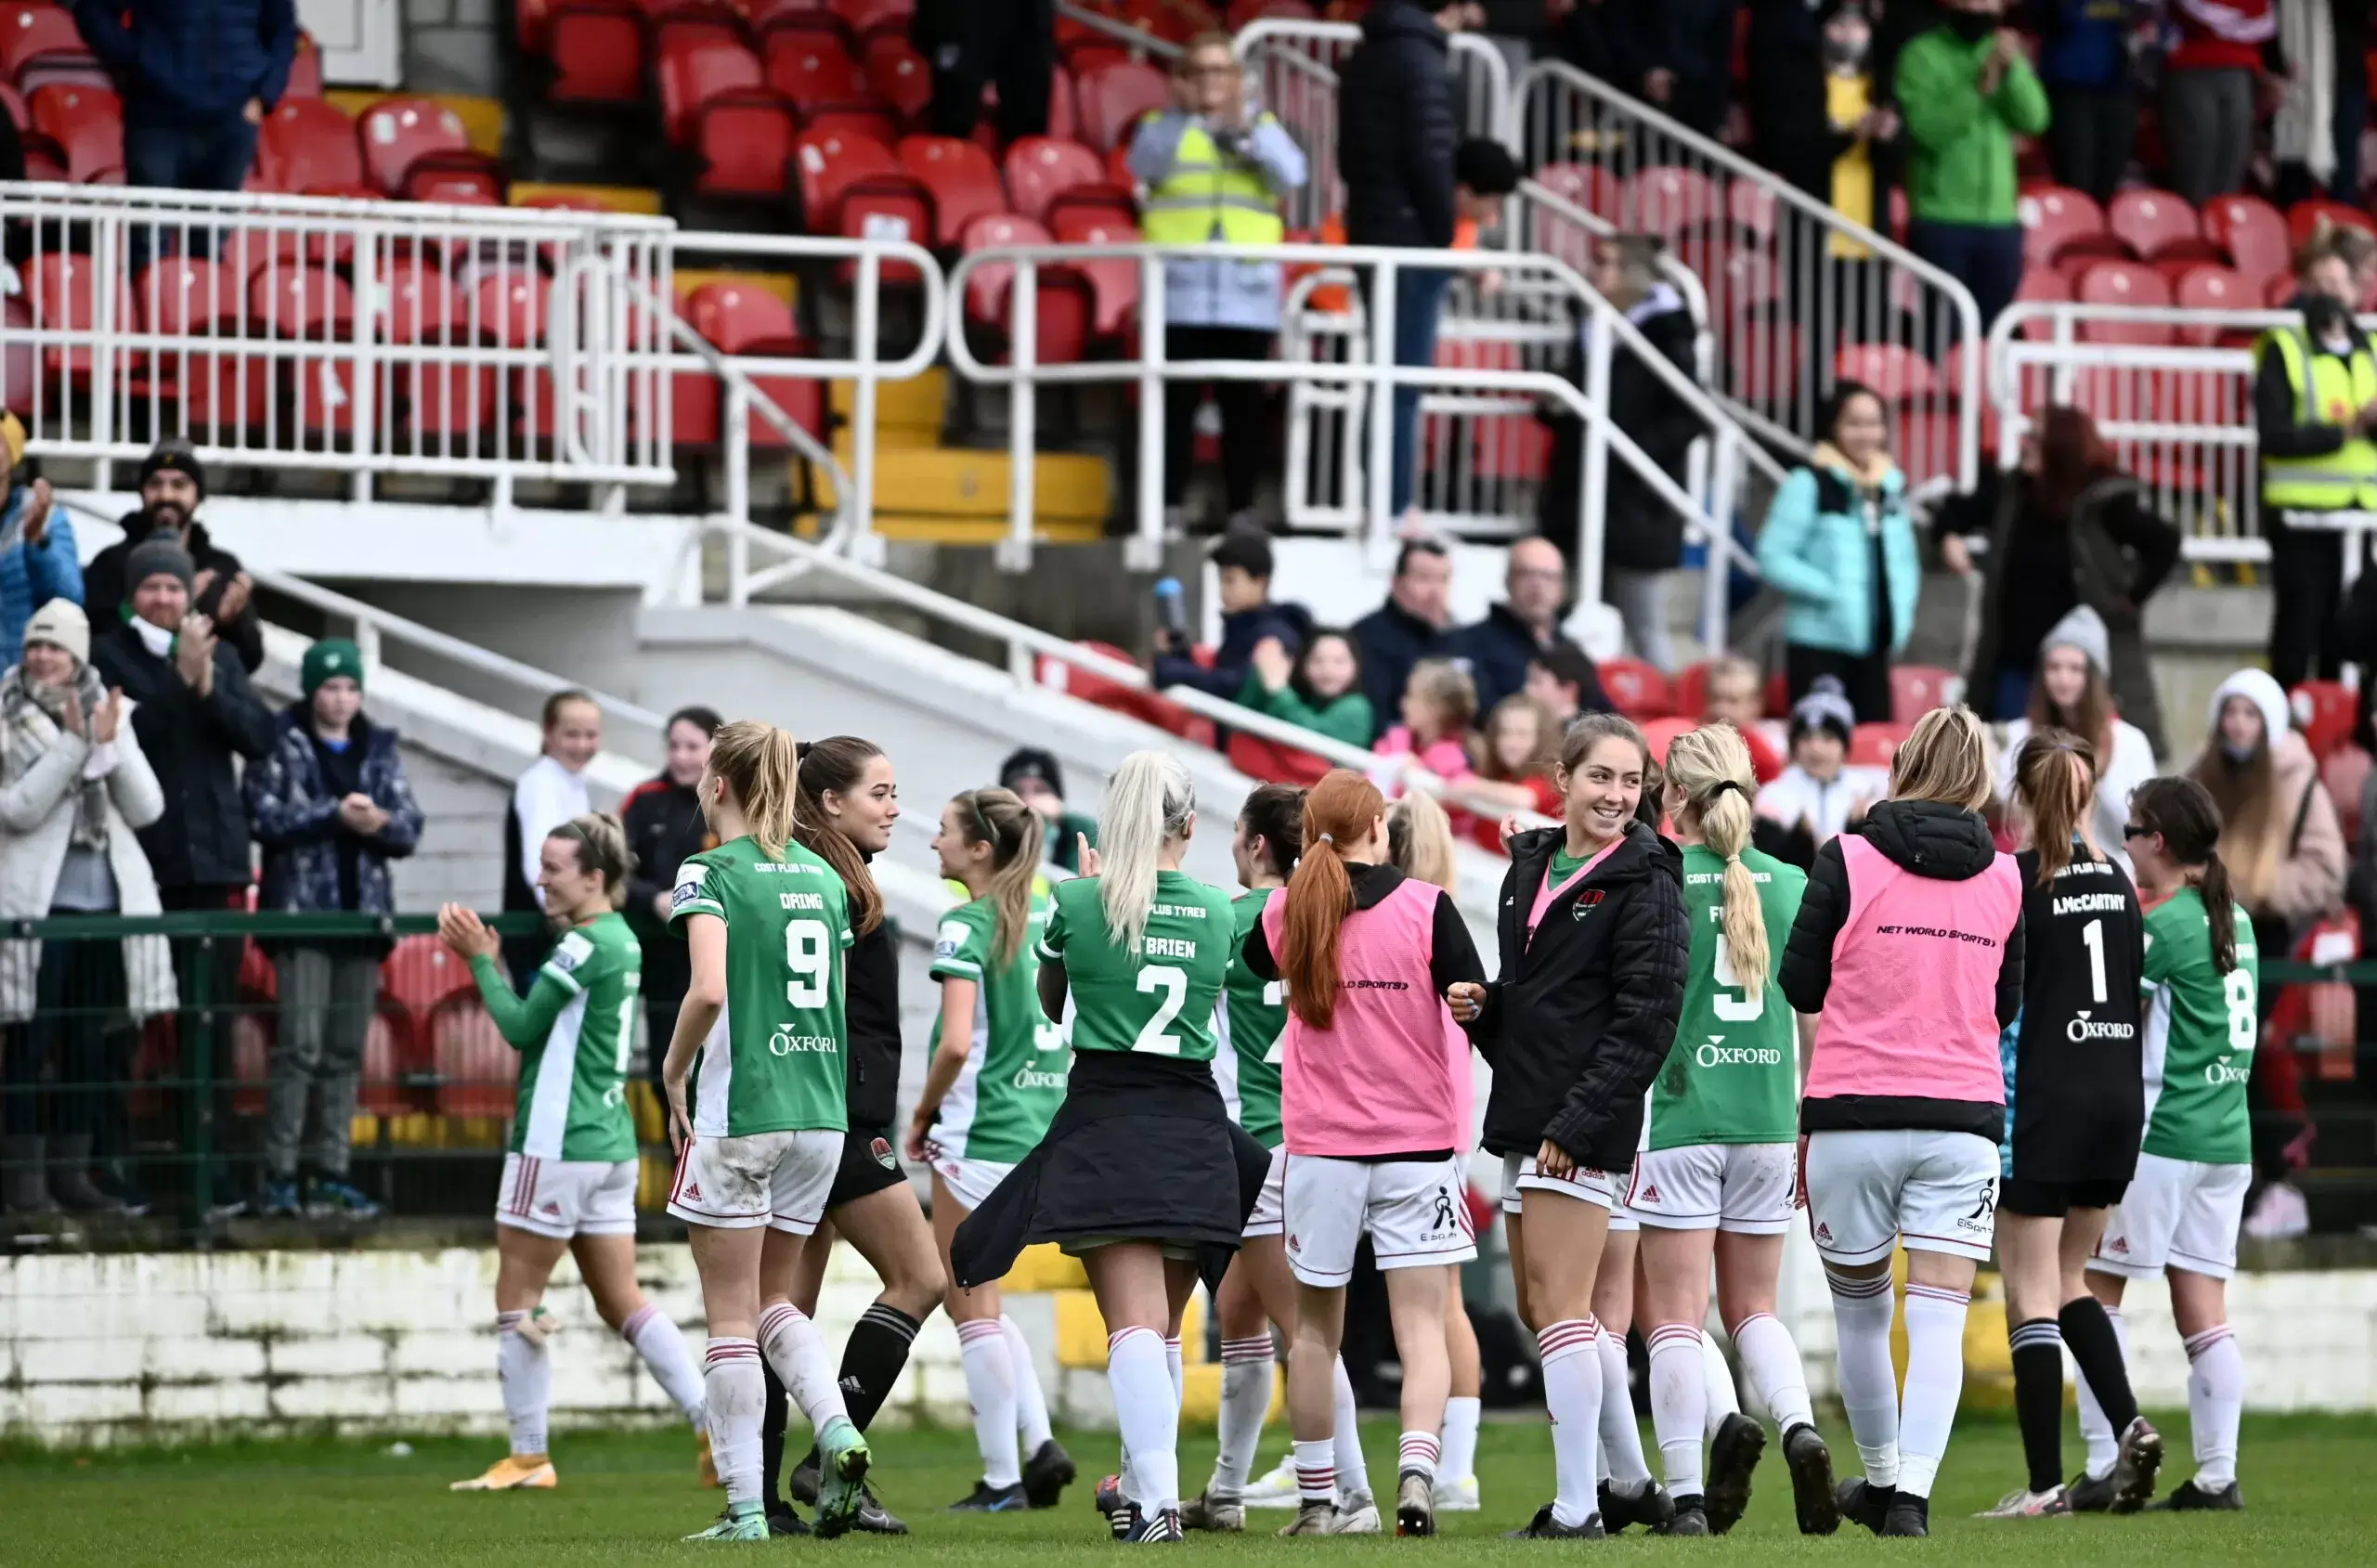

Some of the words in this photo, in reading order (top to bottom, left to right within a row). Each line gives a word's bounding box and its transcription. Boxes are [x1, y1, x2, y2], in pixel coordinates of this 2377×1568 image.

[754, 862, 776, 873] COST
[1686, 874, 1712, 884] COST
[779, 893, 824, 910] DRING
[1174, 905, 1206, 918] TYRES
[1877, 926, 1903, 934] NET
[1904, 927, 1947, 938] WORLD
[1141, 935, 1196, 959] 'BRIEN
[786, 919, 830, 1009] 9
[2083, 919, 2108, 1004] 1
[1357, 980, 1401, 990] SPORTS
[1132, 964, 1188, 1055] 2
[2223, 967, 2257, 1051] 8
[2066, 1018, 2135, 1043] OXFORD
[1695, 1044, 1781, 1068] OXFORD
